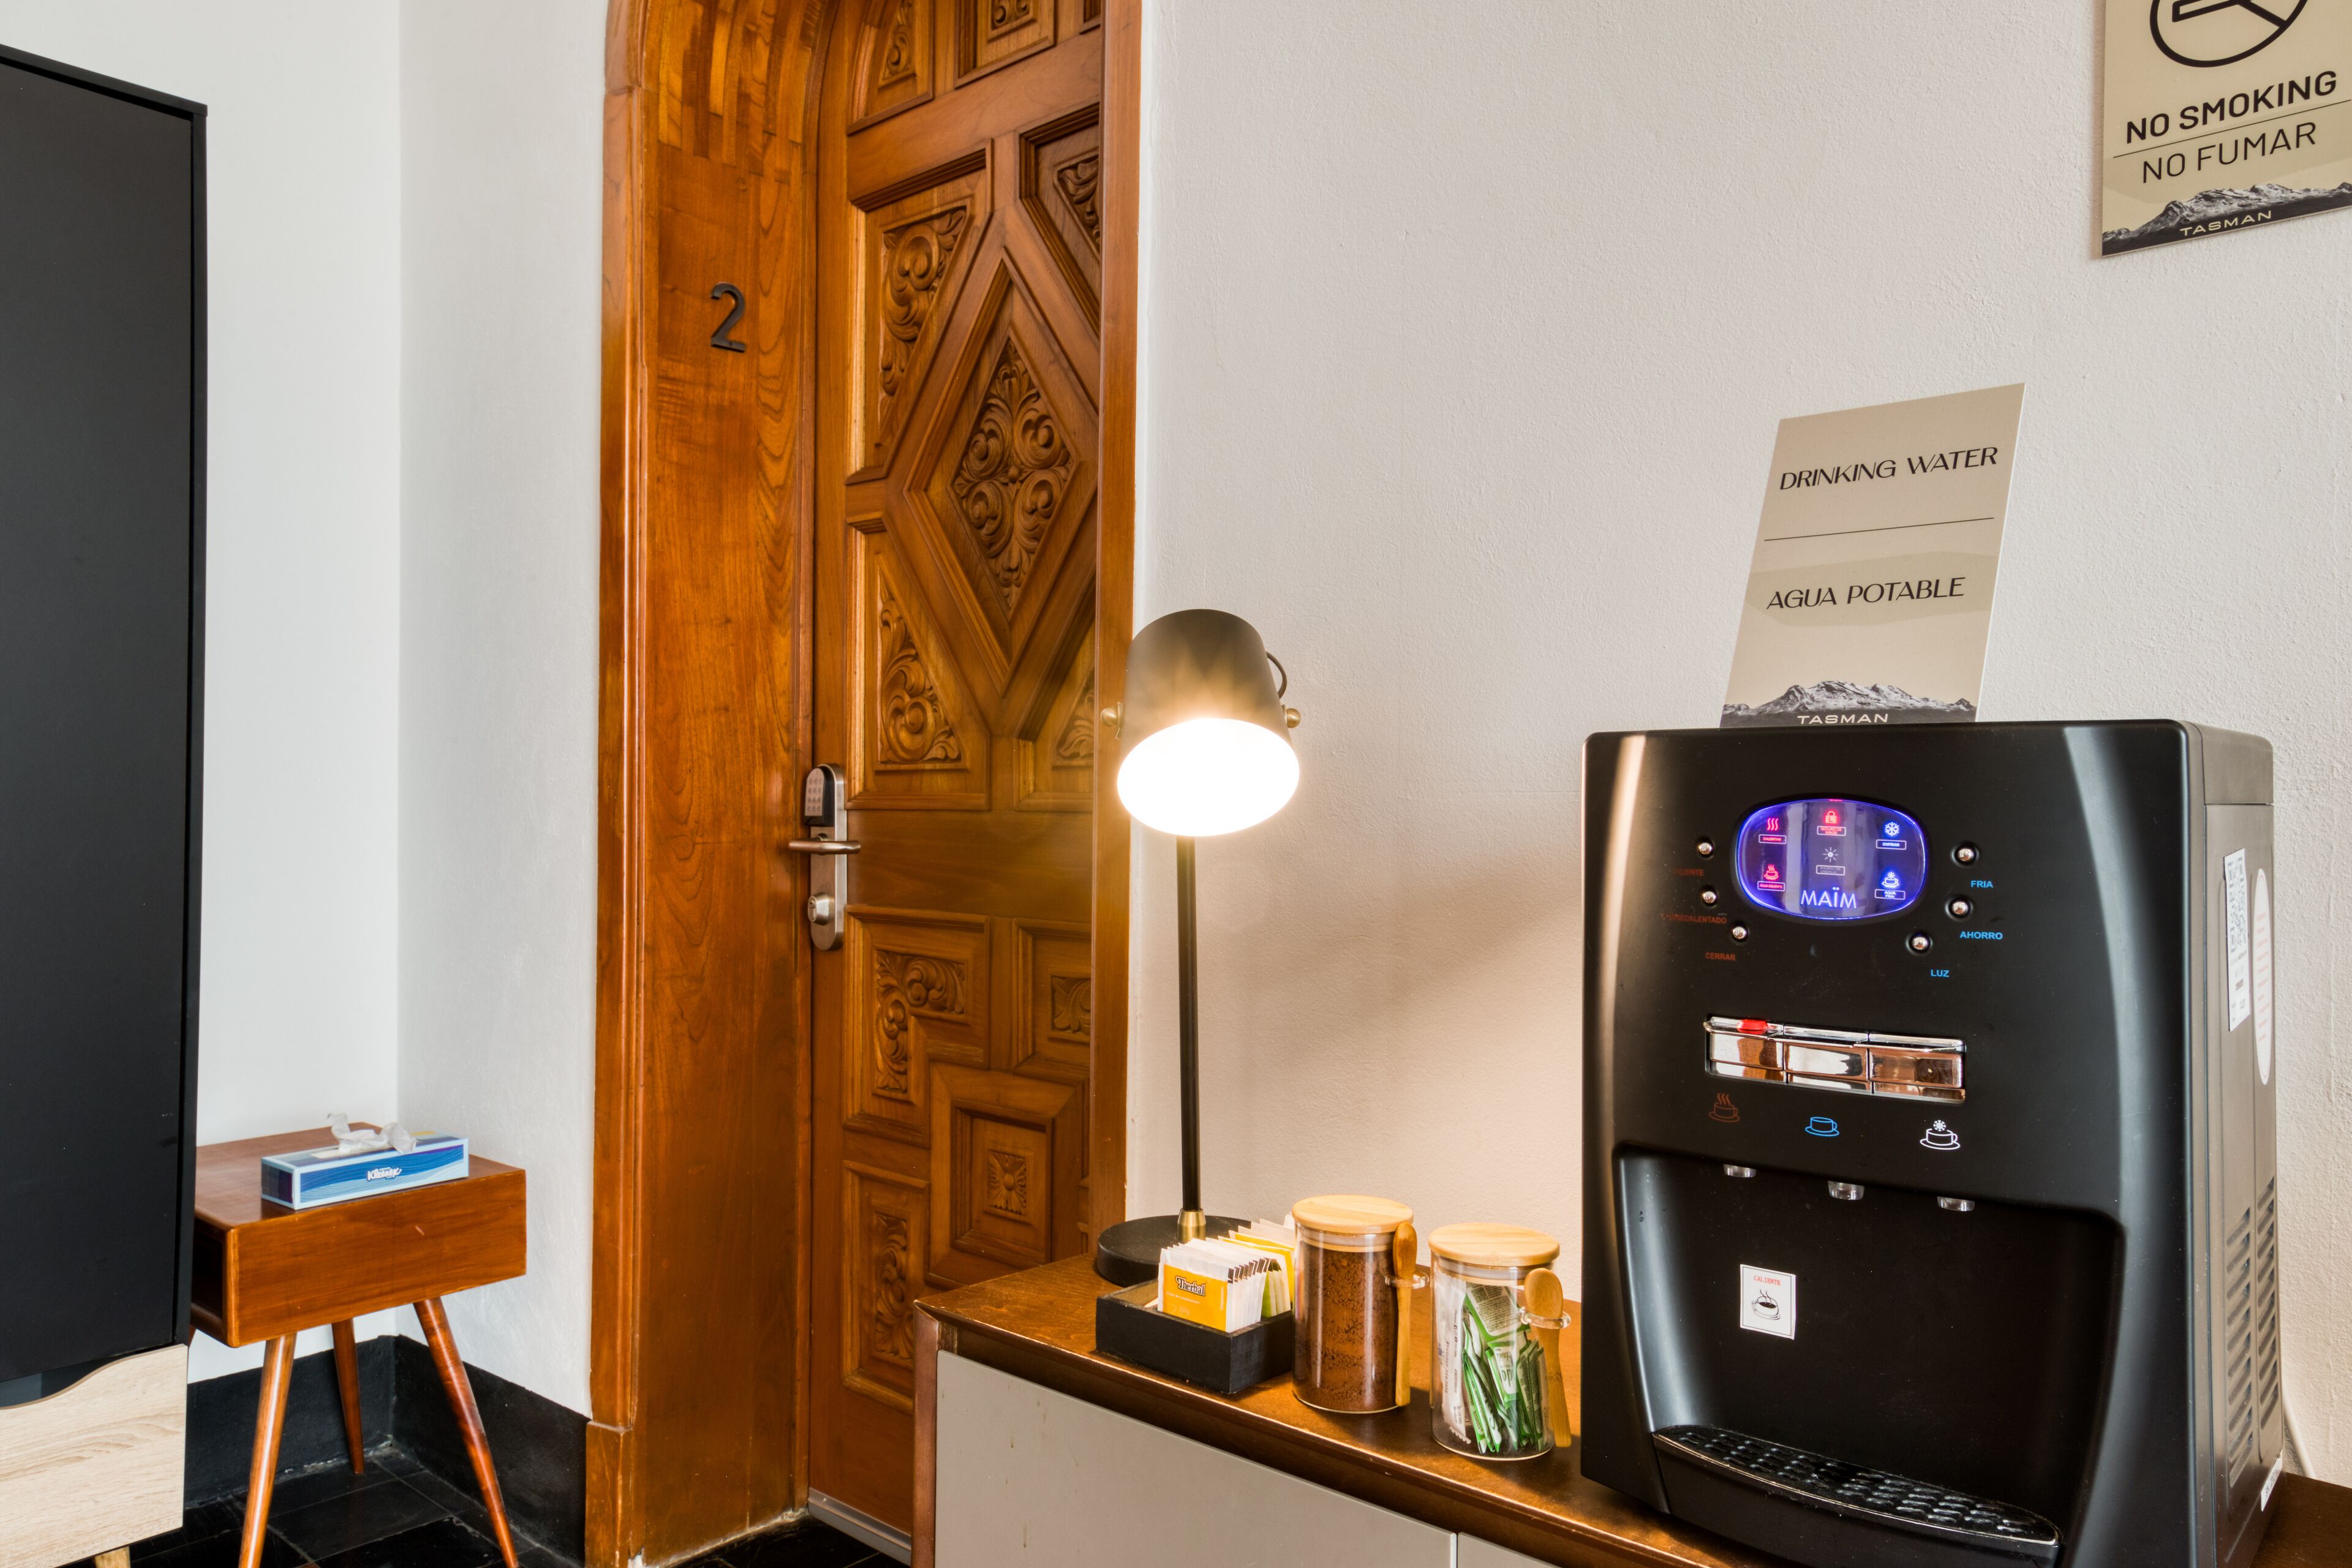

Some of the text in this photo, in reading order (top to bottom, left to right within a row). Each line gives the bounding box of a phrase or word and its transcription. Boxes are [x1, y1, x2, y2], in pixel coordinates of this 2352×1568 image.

[2127, 70, 2337, 144] NO SMOKING
[2143, 122, 2316, 183] NO FUMAR
[2179, 210, 2272, 236] TASMAN
[710, 281, 745, 353] 2
[1779, 447, 1999, 490] DRINKING WATER
[1766, 577, 1966, 609] AGUA POTABLE
[1797, 714, 1888, 725] TASMAN
[1970, 880, 1993, 889] FRIA
[1661, 913, 1727, 924] RECALENTADO
[1959, 931, 2003, 941] AHORRO
[1705, 952, 1736, 961] CERRAR
[1930, 969, 1950, 978] LUZ
[368, 1167, 402, 1181] Kleenex
[1175, 1275, 1205, 1297] Therbal
[1754, 1275, 1781, 1286] CALIENTE
